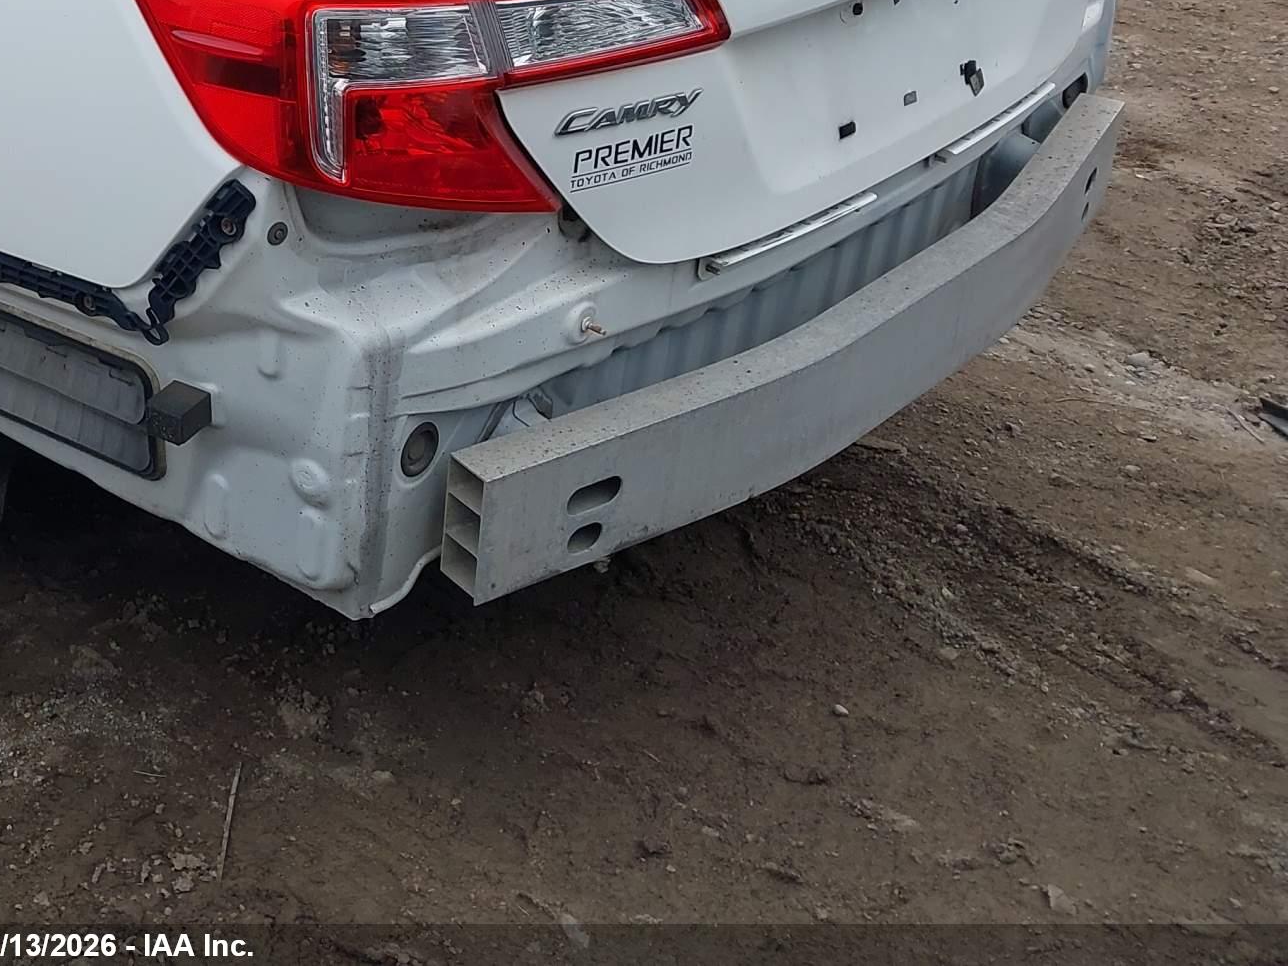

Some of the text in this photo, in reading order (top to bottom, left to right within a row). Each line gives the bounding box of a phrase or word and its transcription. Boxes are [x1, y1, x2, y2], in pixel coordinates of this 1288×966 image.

[554, 88, 704, 137] CAMRY
[570, 151, 693, 190] TOYOTA OF RICHMOND
[573, 125, 694, 174] PREMIER
